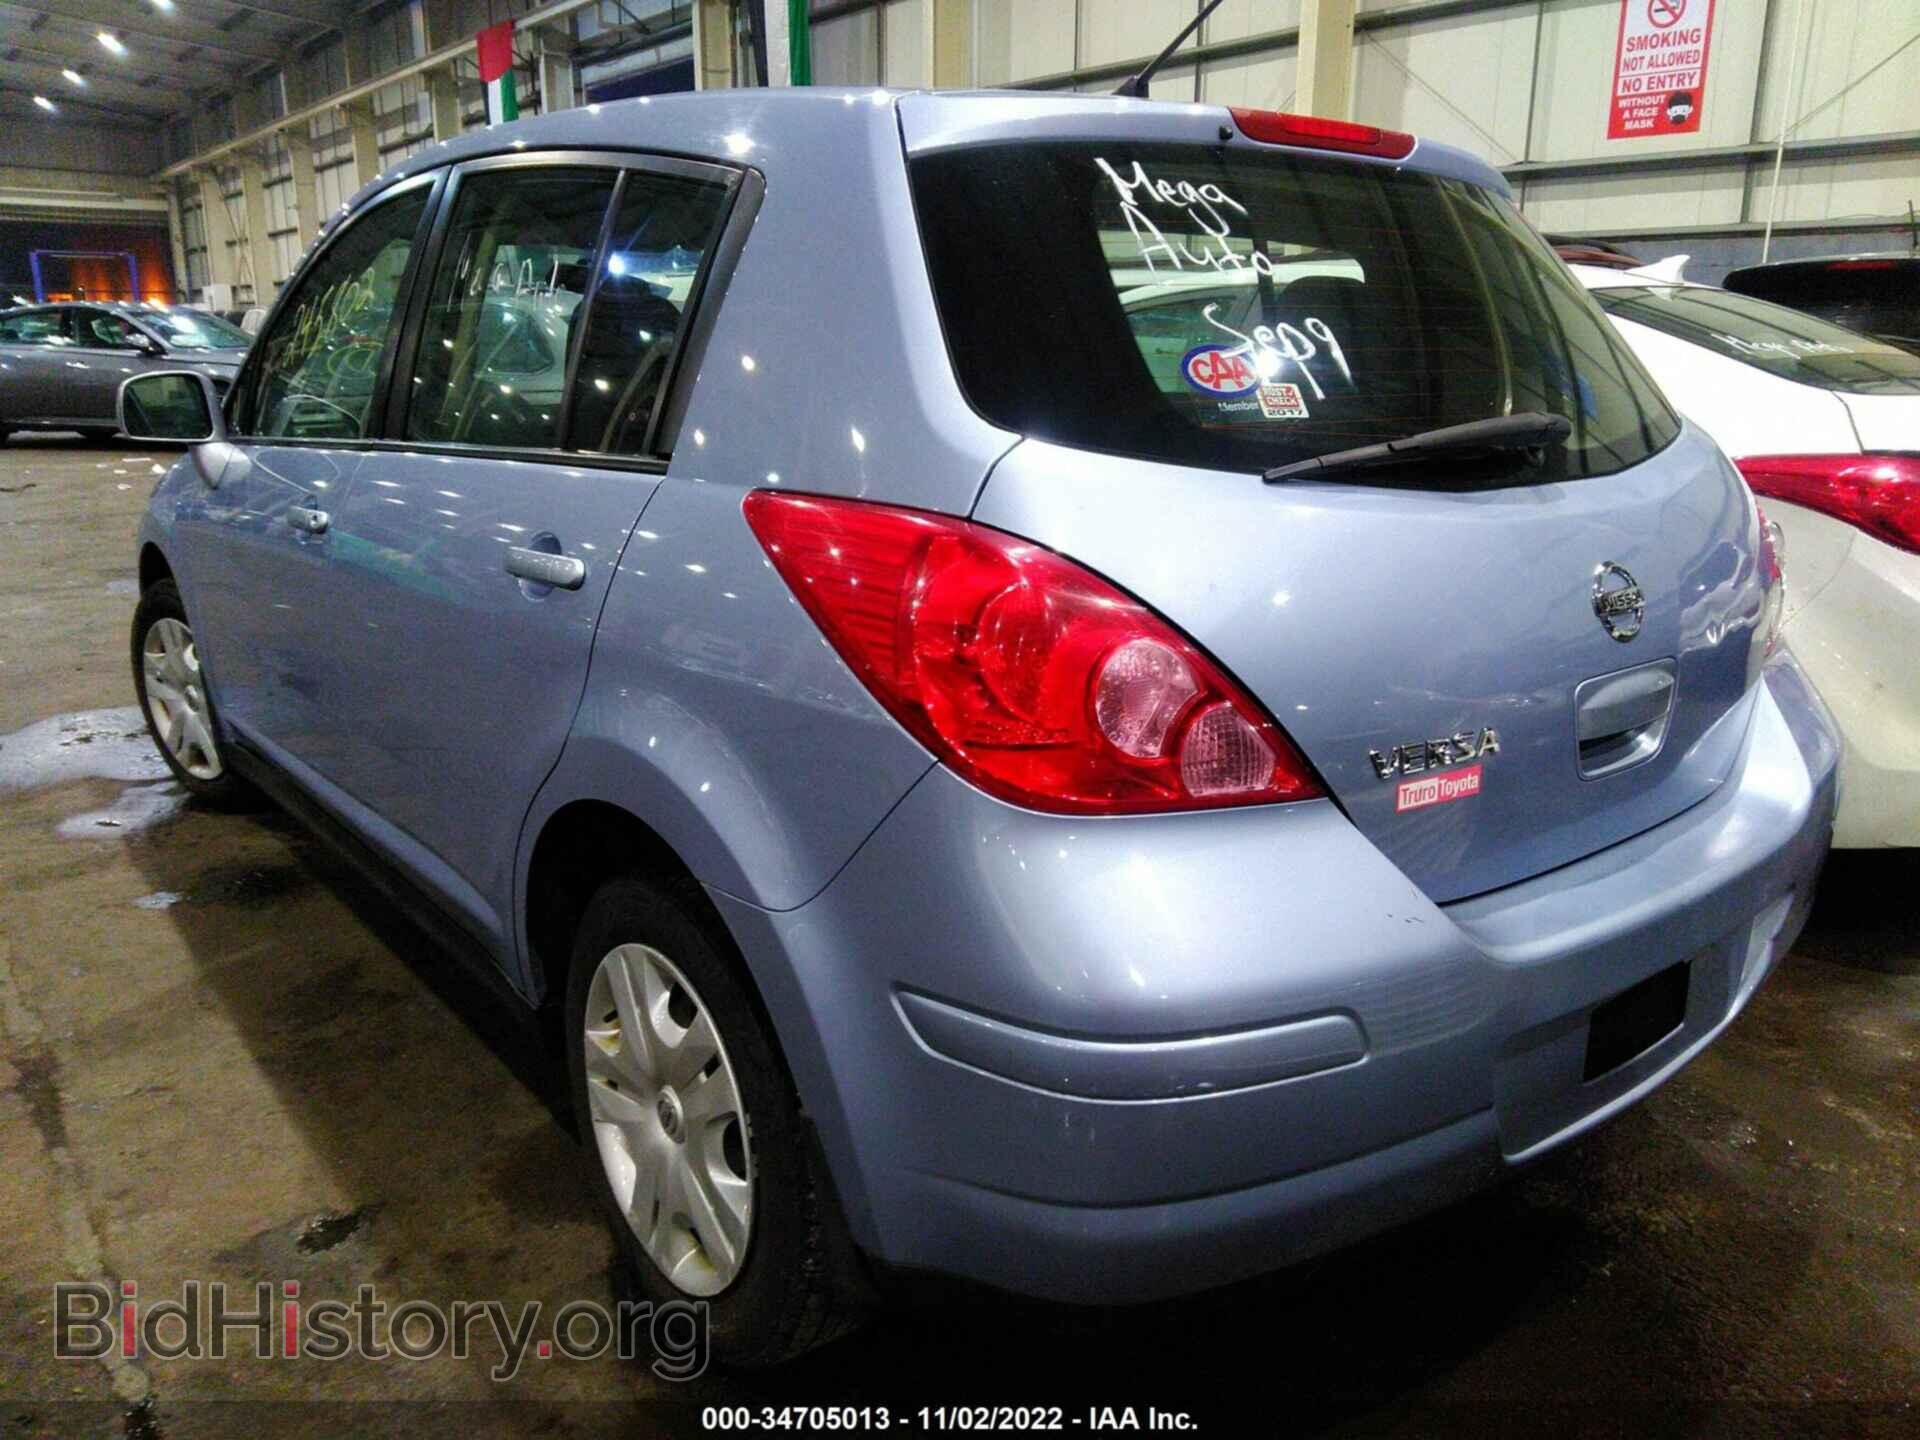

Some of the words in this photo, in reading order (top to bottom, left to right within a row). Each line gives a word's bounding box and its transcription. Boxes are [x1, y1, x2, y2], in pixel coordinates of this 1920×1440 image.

[1626, 28, 1701, 52] SMOKING
[1622, 56, 1645, 72] NOT
[1647, 49, 1700, 69] ALLOWED
[1621, 78, 1642, 93] NO
[1647, 72, 1697, 91] ENTRY
[1618, 94, 1666, 108] WITHOUT
[1622, 110, 1630, 119] A
[1632, 107, 1659, 117] FACE
[1624, 118, 1655, 130] MASK
[1094, 157, 1249, 238] Mega
[1119, 200, 1274, 273] Auto
[1191, 351, 1255, 390] CAA
[1267, 408, 1303, 417] 2017
[1369, 727, 1501, 780] VERSA
[1401, 785, 1436, 806] Truro
[1439, 772, 1480, 798] Toyota
